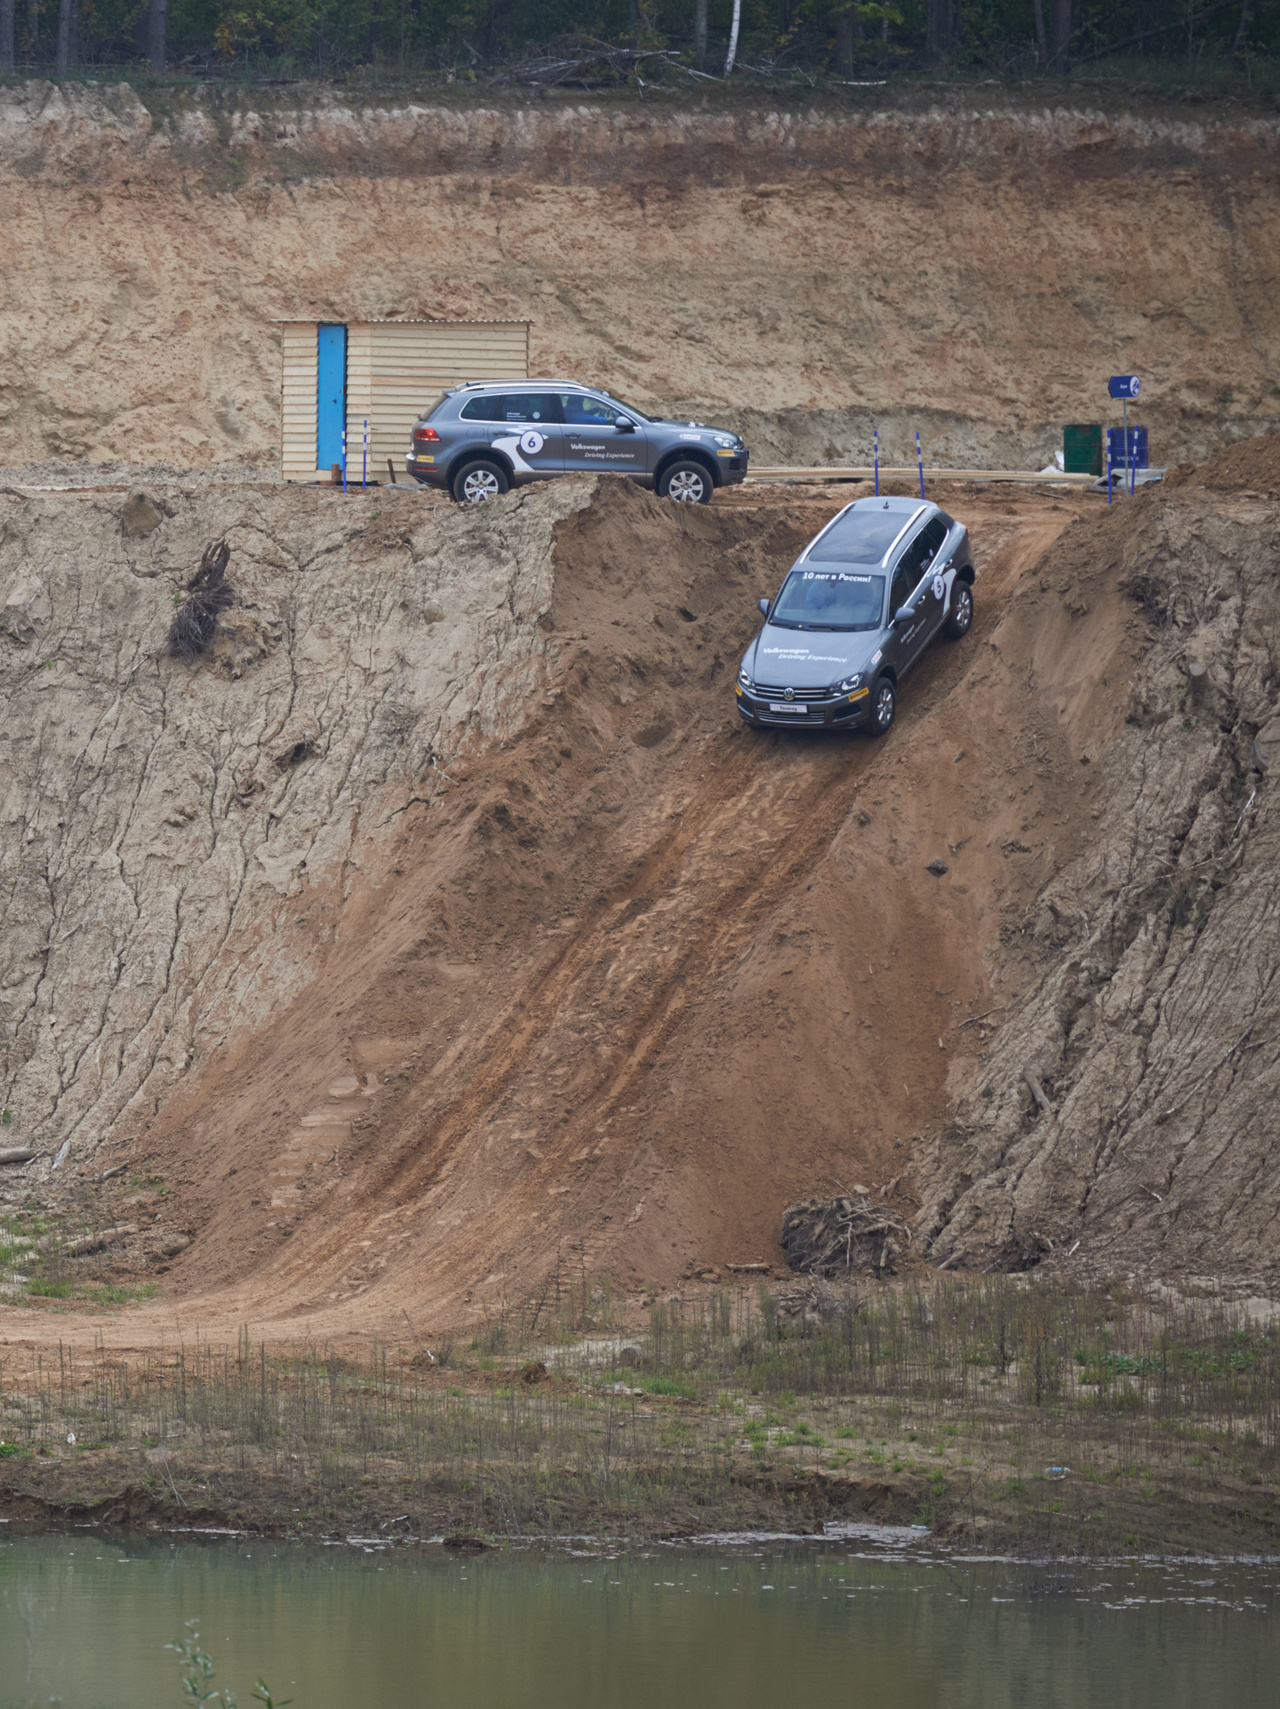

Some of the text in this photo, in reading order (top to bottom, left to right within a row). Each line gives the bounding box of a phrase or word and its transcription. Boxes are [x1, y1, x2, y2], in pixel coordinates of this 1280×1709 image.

[528, 437, 536, 448] 6
[570, 443, 606, 451] Volkswagen
[802, 572, 814, 580] 10
[838, 573, 872, 583] России!
[778, 653, 848, 663] Driving Experience
